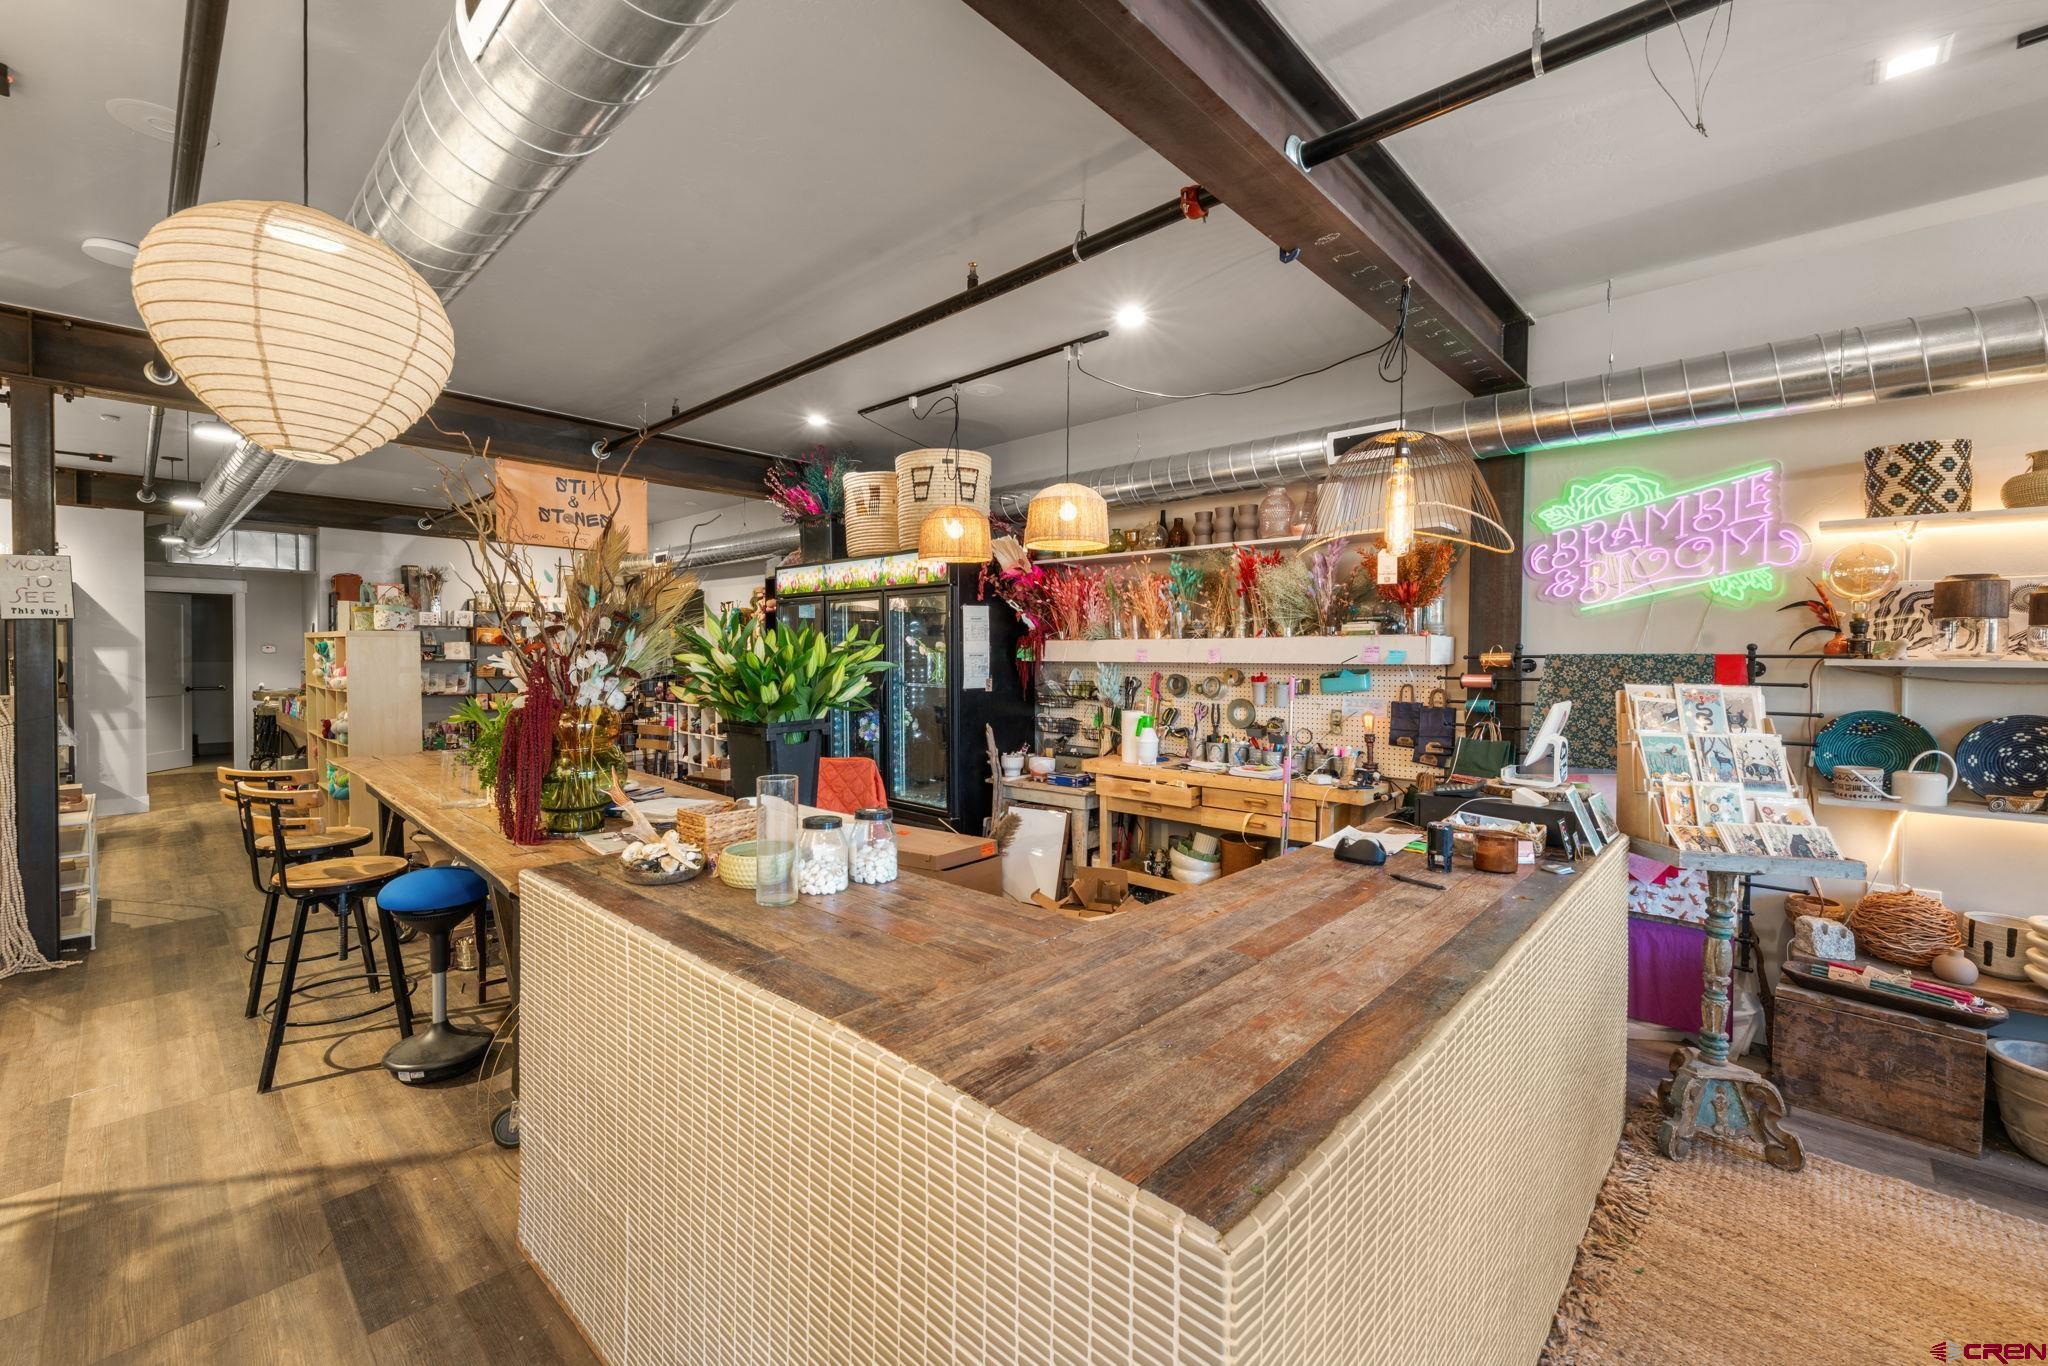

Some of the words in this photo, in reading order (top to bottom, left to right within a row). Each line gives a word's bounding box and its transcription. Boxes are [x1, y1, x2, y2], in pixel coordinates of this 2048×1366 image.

[567, 495, 579, 508] &
[1533, 470, 1774, 573] BRAMBLE
[1545, 570, 1579, 598] &
[1579, 518, 1802, 604] BLOOM
[23, 575, 53, 588] TO
[8, 586, 57, 604] SEE
[11, 607, 36, 615] This
